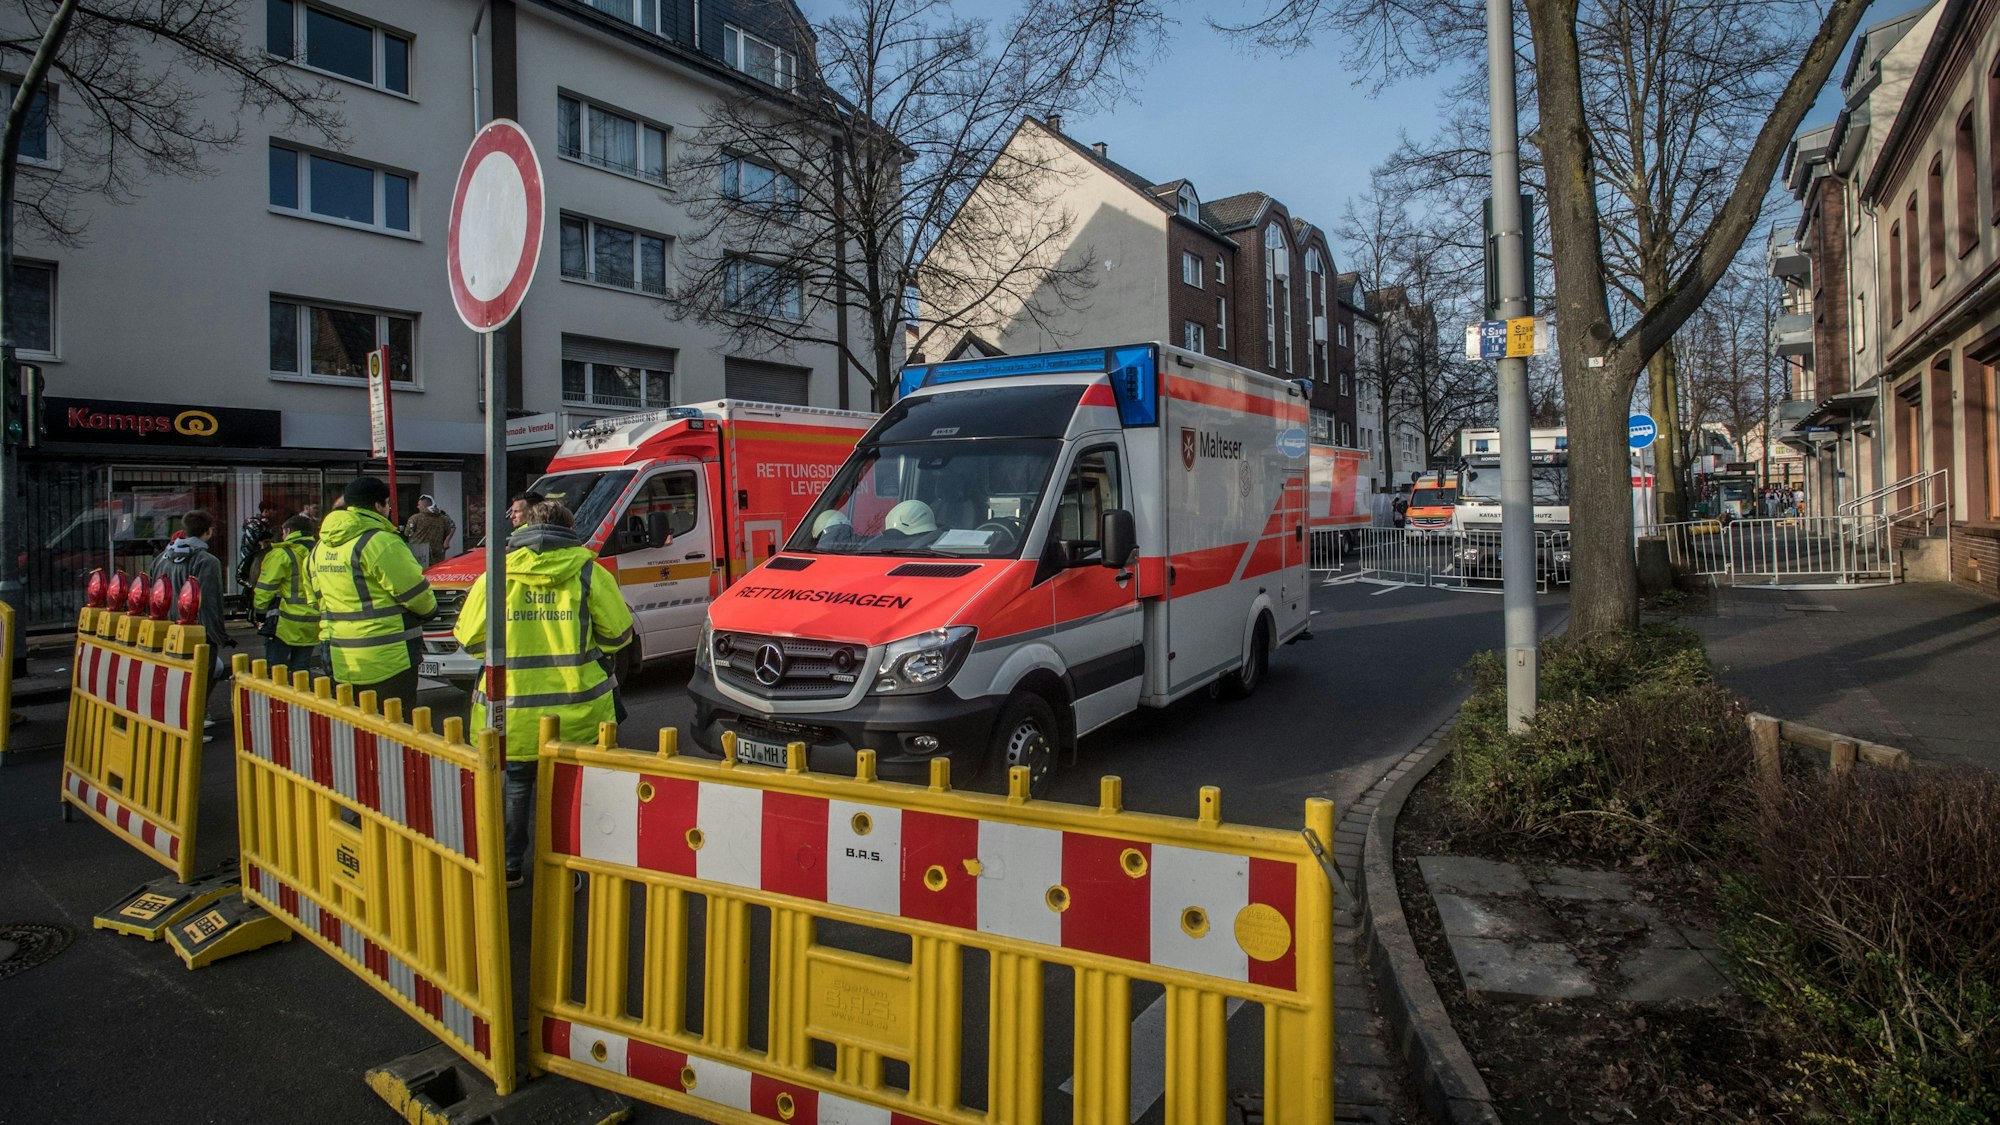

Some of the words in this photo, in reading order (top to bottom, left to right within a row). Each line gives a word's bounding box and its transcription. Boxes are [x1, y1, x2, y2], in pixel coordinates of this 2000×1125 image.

[68, 407, 171, 436] Kamps
[528, 422, 554, 433] Venezia
[602, 412, 660, 428] RETTUNGSDIENST
[1200, 431, 1242, 460] Malteser
[325, 550, 338, 561] Stadt
[317, 562, 347, 573] Leverkusen
[524, 590, 556, 604] Stadt
[735, 586, 912, 609] RETTUNGSWAGEN
[506, 608, 573, 621] Leverkusen
[738, 740, 757, 760] LEV
[764, 746, 778, 763] MH
[846, 847, 883, 862] B.A.S.
